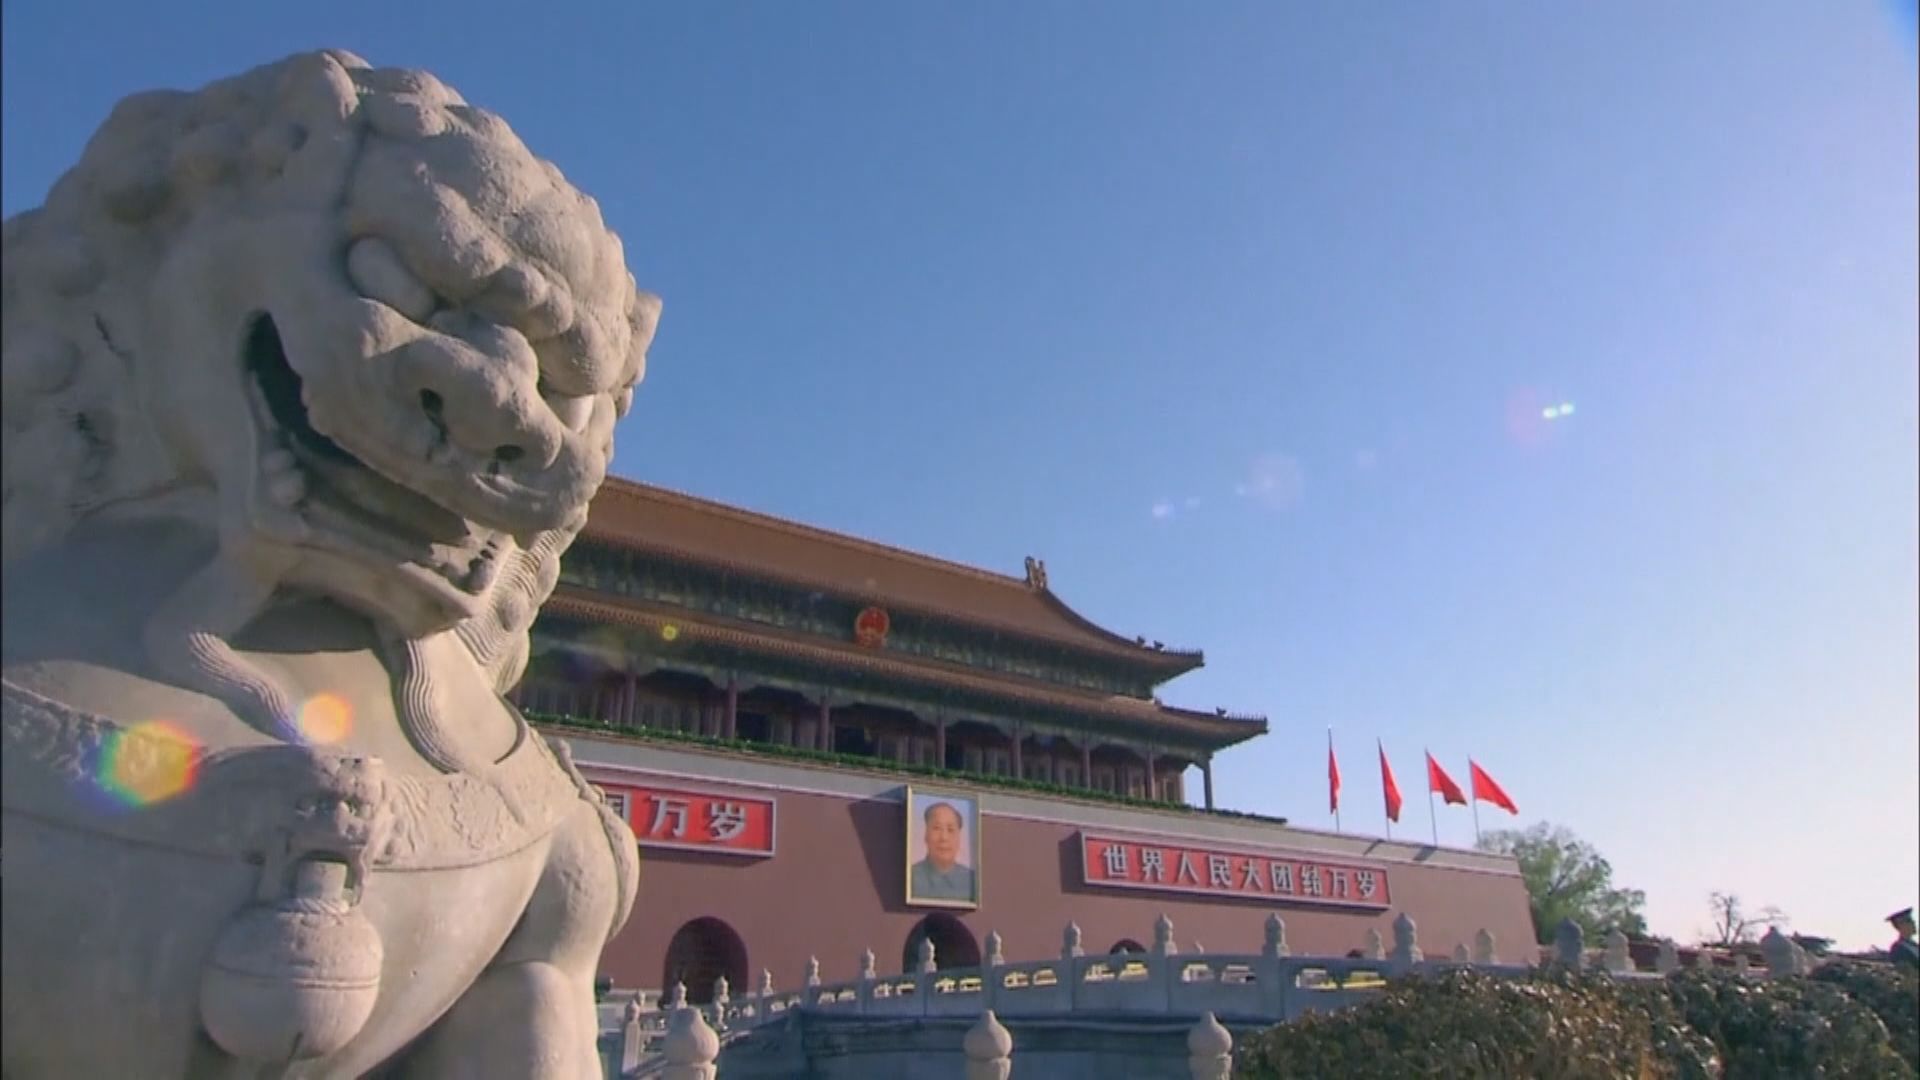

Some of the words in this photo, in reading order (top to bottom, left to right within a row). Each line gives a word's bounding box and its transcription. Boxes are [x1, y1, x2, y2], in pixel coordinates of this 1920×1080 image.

[1104, 845, 1376, 898] 世界人民大团结万岁
